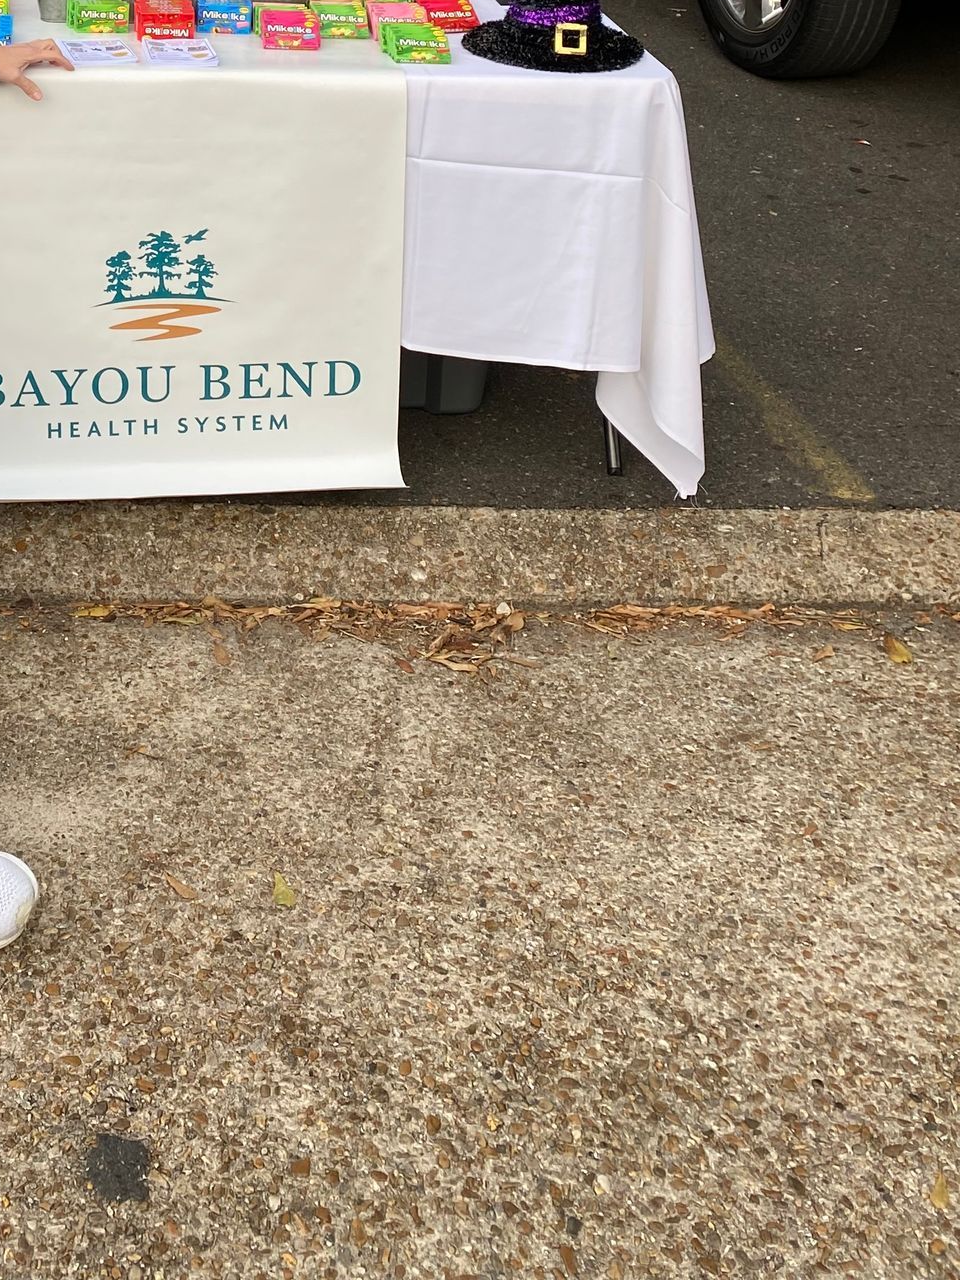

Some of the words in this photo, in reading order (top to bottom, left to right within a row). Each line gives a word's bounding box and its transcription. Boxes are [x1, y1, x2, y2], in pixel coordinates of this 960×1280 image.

[81, 10, 107, 19] Mike
[109, 11, 124, 20] Ike
[202, 10, 228, 19] Mike
[230, 12, 246, 21] Ike
[320, 13, 346, 22] Mike
[348, 15, 364, 23] Ike
[429, 11, 455, 19] Mike
[267, 24, 292, 32] Mike
[296, 25, 312, 34] Ike
[400, 38, 427, 47] Mike
[429, 40, 445, 48] Ike
[199, 359, 363, 402] BEND
[47, 418, 159, 439] HEALTH
[177, 414, 289, 434] SYSTEM
